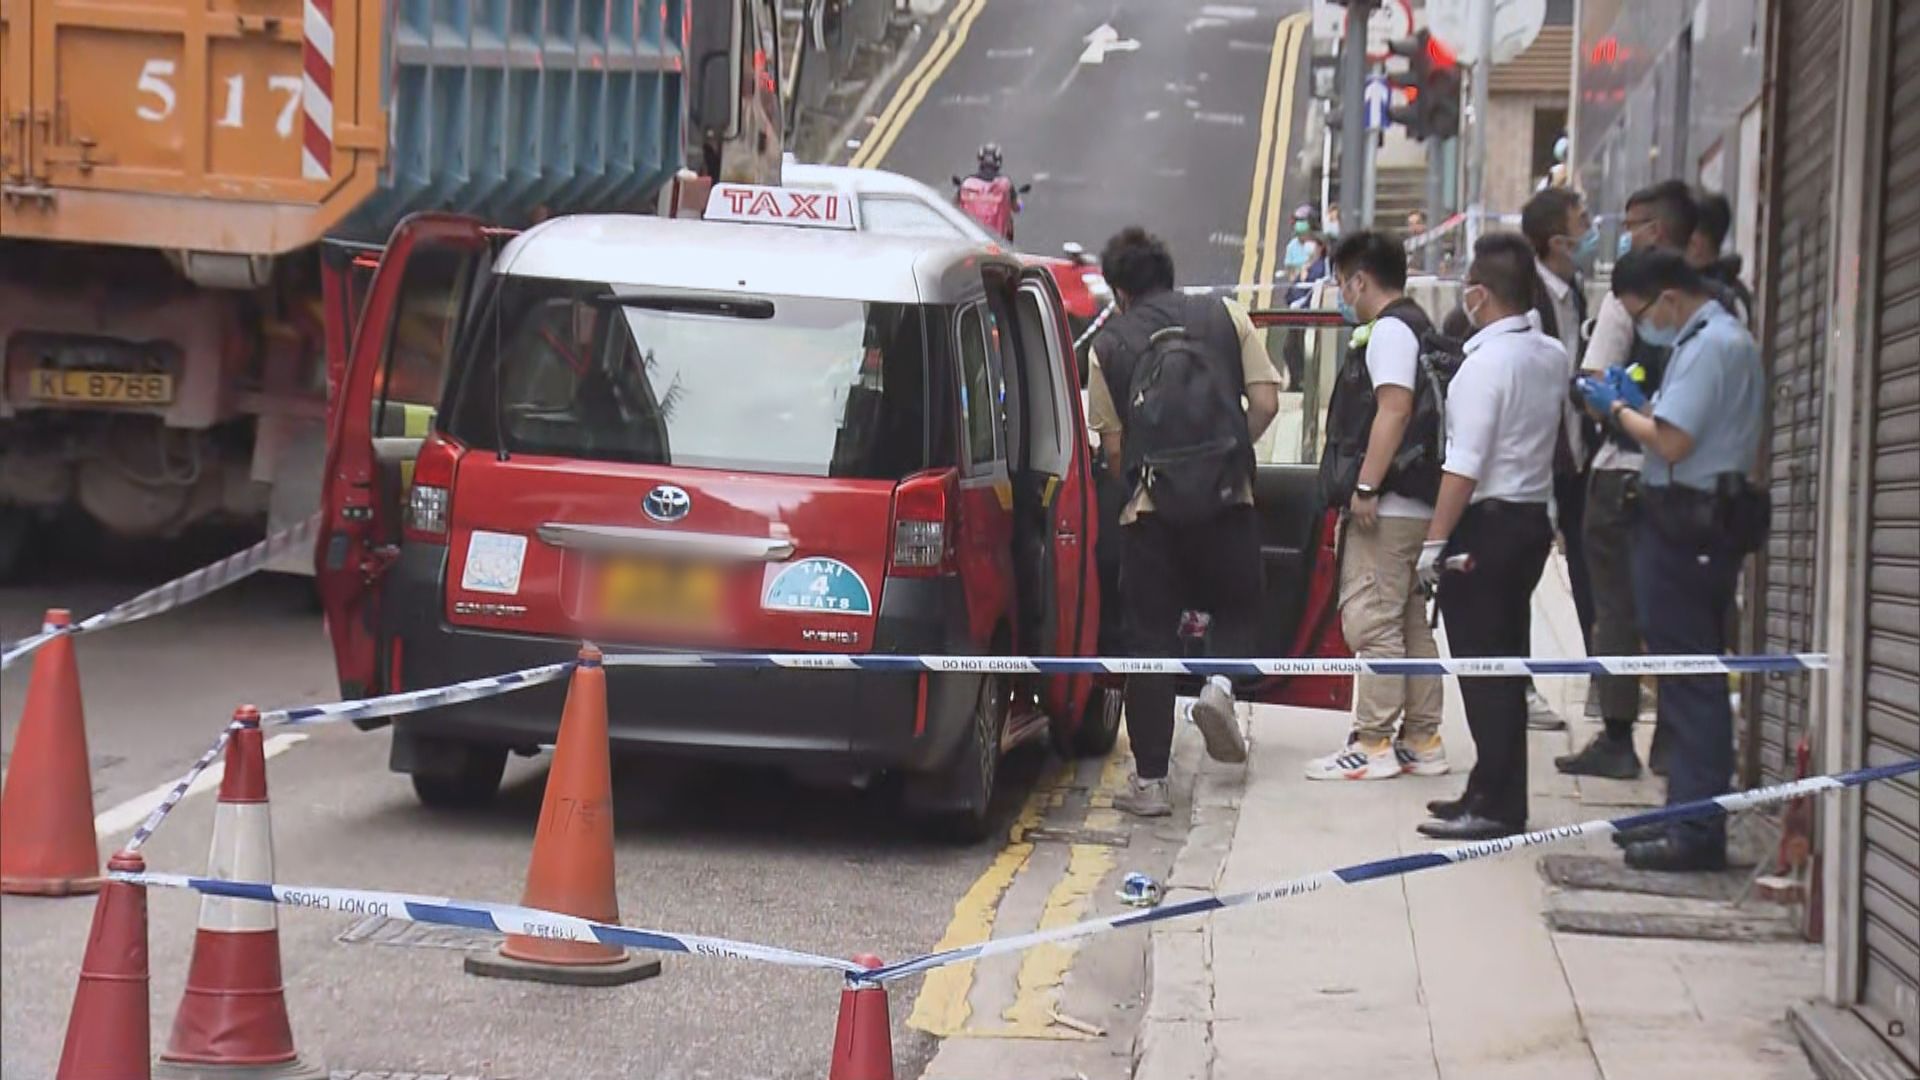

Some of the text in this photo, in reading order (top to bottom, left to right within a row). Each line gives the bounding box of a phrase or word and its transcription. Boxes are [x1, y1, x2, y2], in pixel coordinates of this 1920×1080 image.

[723, 188, 838, 221] TAXI
[801, 562, 843, 577] TAXI
[810, 575, 829, 595] 4
[788, 595, 849, 609] SEATS
[942, 660, 1028, 670] DO NOT CROSS
[1273, 662, 1362, 672] DO NOT CROSS
[283, 890, 389, 917] DO NOT CROSS
